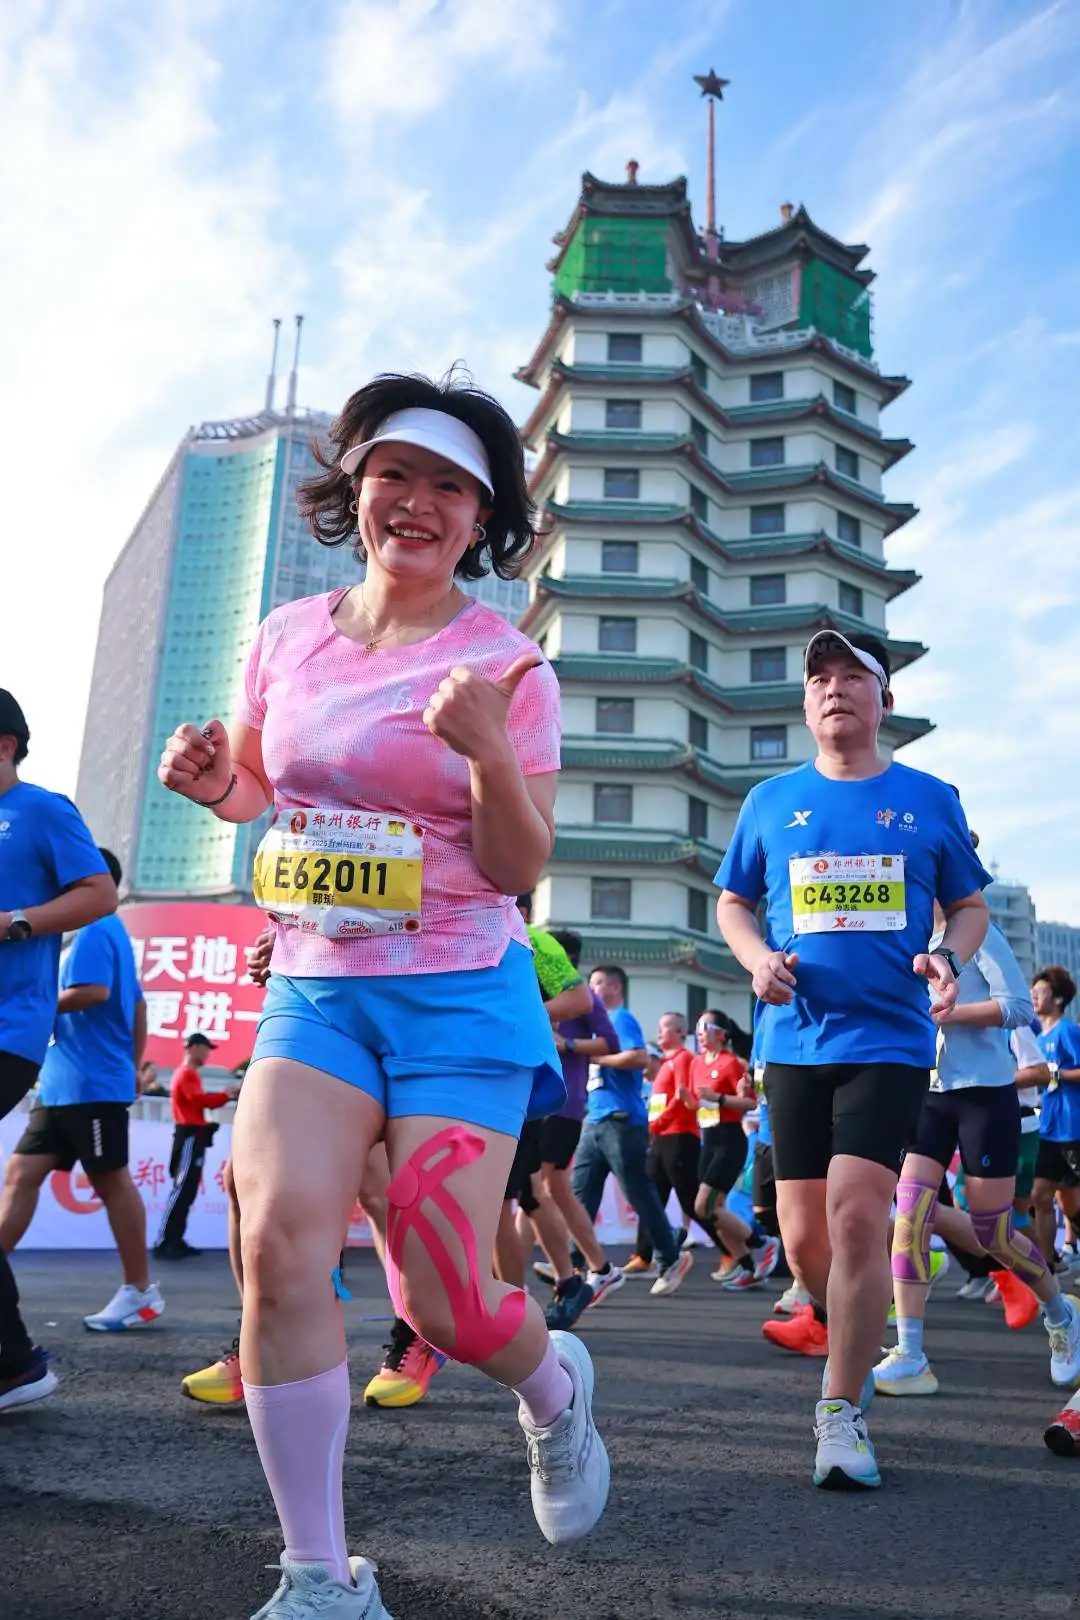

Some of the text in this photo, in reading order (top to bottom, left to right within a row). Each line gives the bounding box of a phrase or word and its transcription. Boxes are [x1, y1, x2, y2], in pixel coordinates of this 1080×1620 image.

[312, 811, 382, 832] 郑州银行
[833, 858, 876, 868] 郑州银行
[274, 856, 387, 895] E62011
[803, 884, 891, 906] C43268
